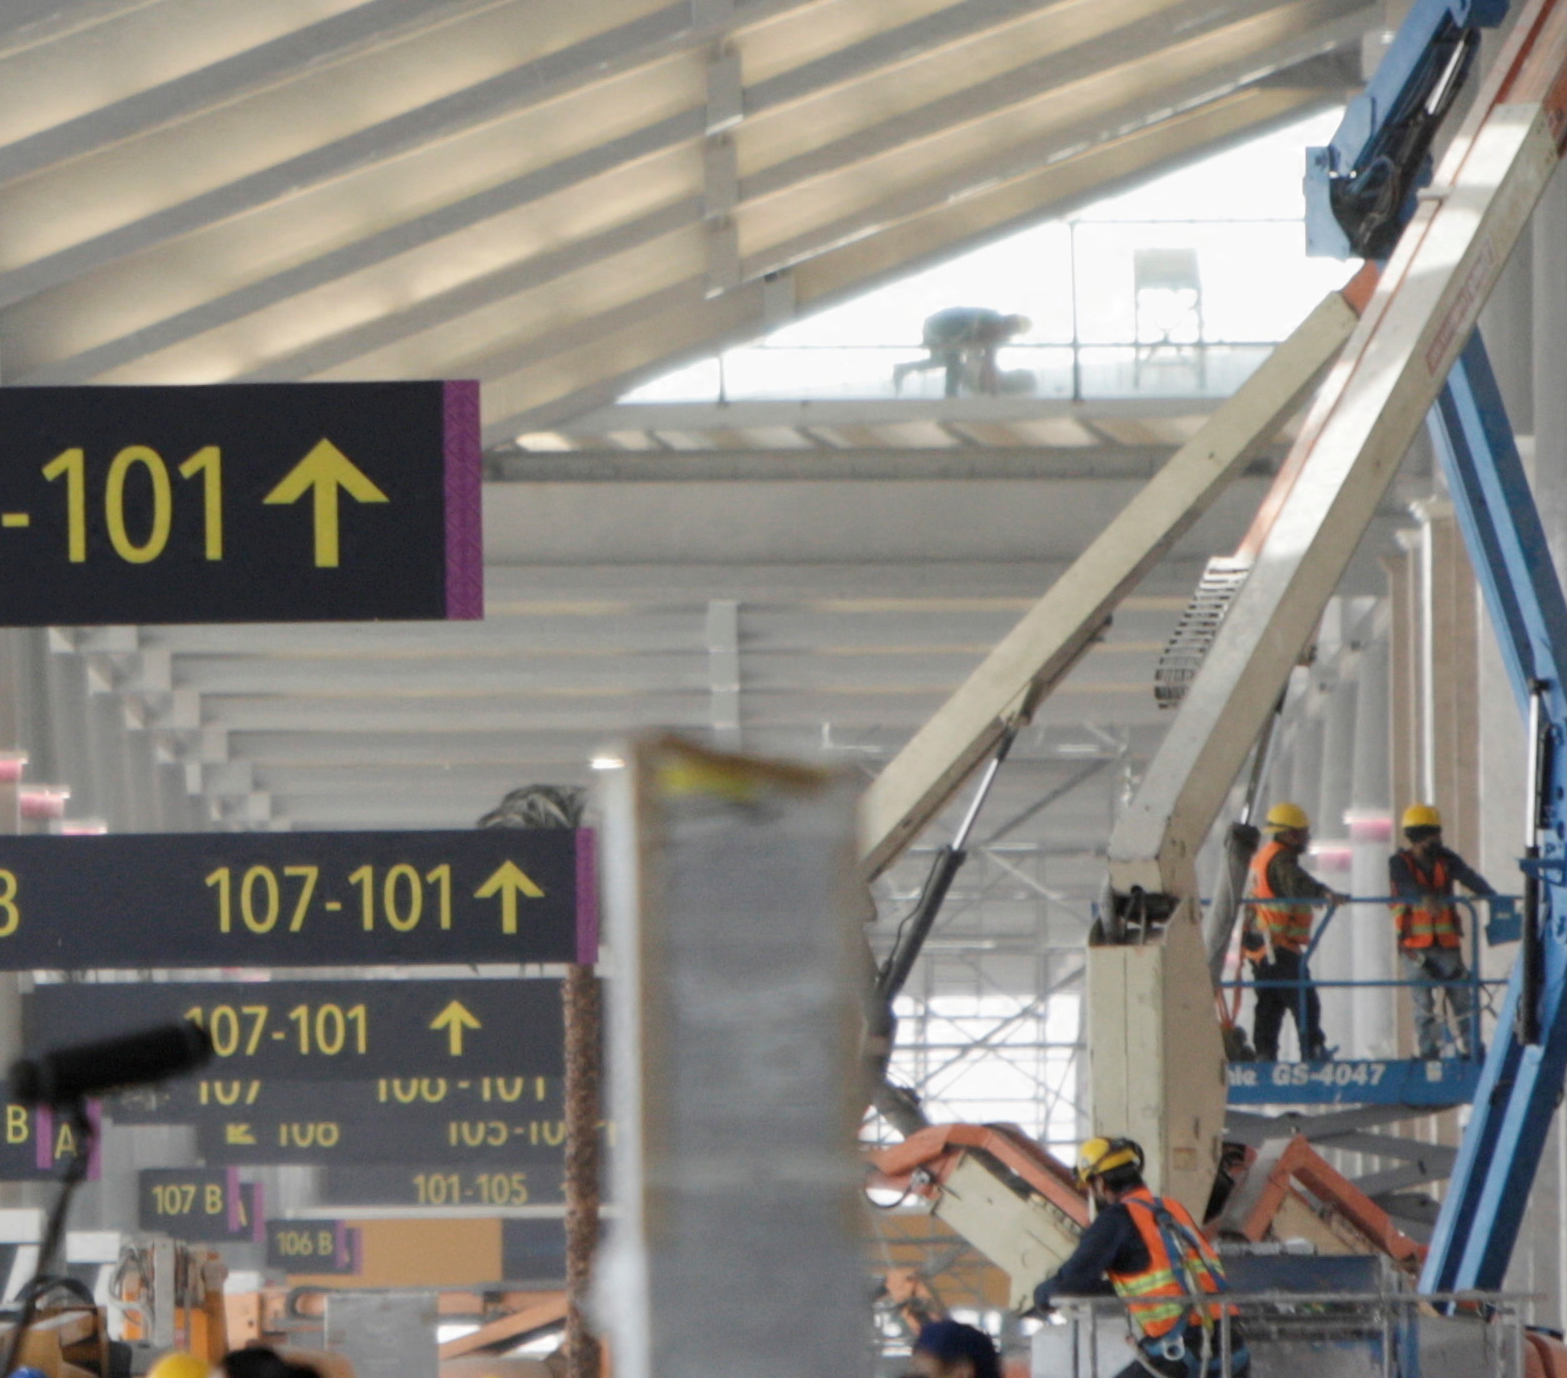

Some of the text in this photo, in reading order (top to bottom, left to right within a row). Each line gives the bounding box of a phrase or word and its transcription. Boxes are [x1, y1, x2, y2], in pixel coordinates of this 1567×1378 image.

[205, 863, 451, 934] 107-101
[1272, 1062, 1386, 1087] GS-4047
[6, 1105, 28, 1144] B
[152, 1185, 196, 1215] 107
[205, 1184, 223, 1215] B
[277, 1230, 314, 1256] 106
[317, 1230, 333, 1256] B
